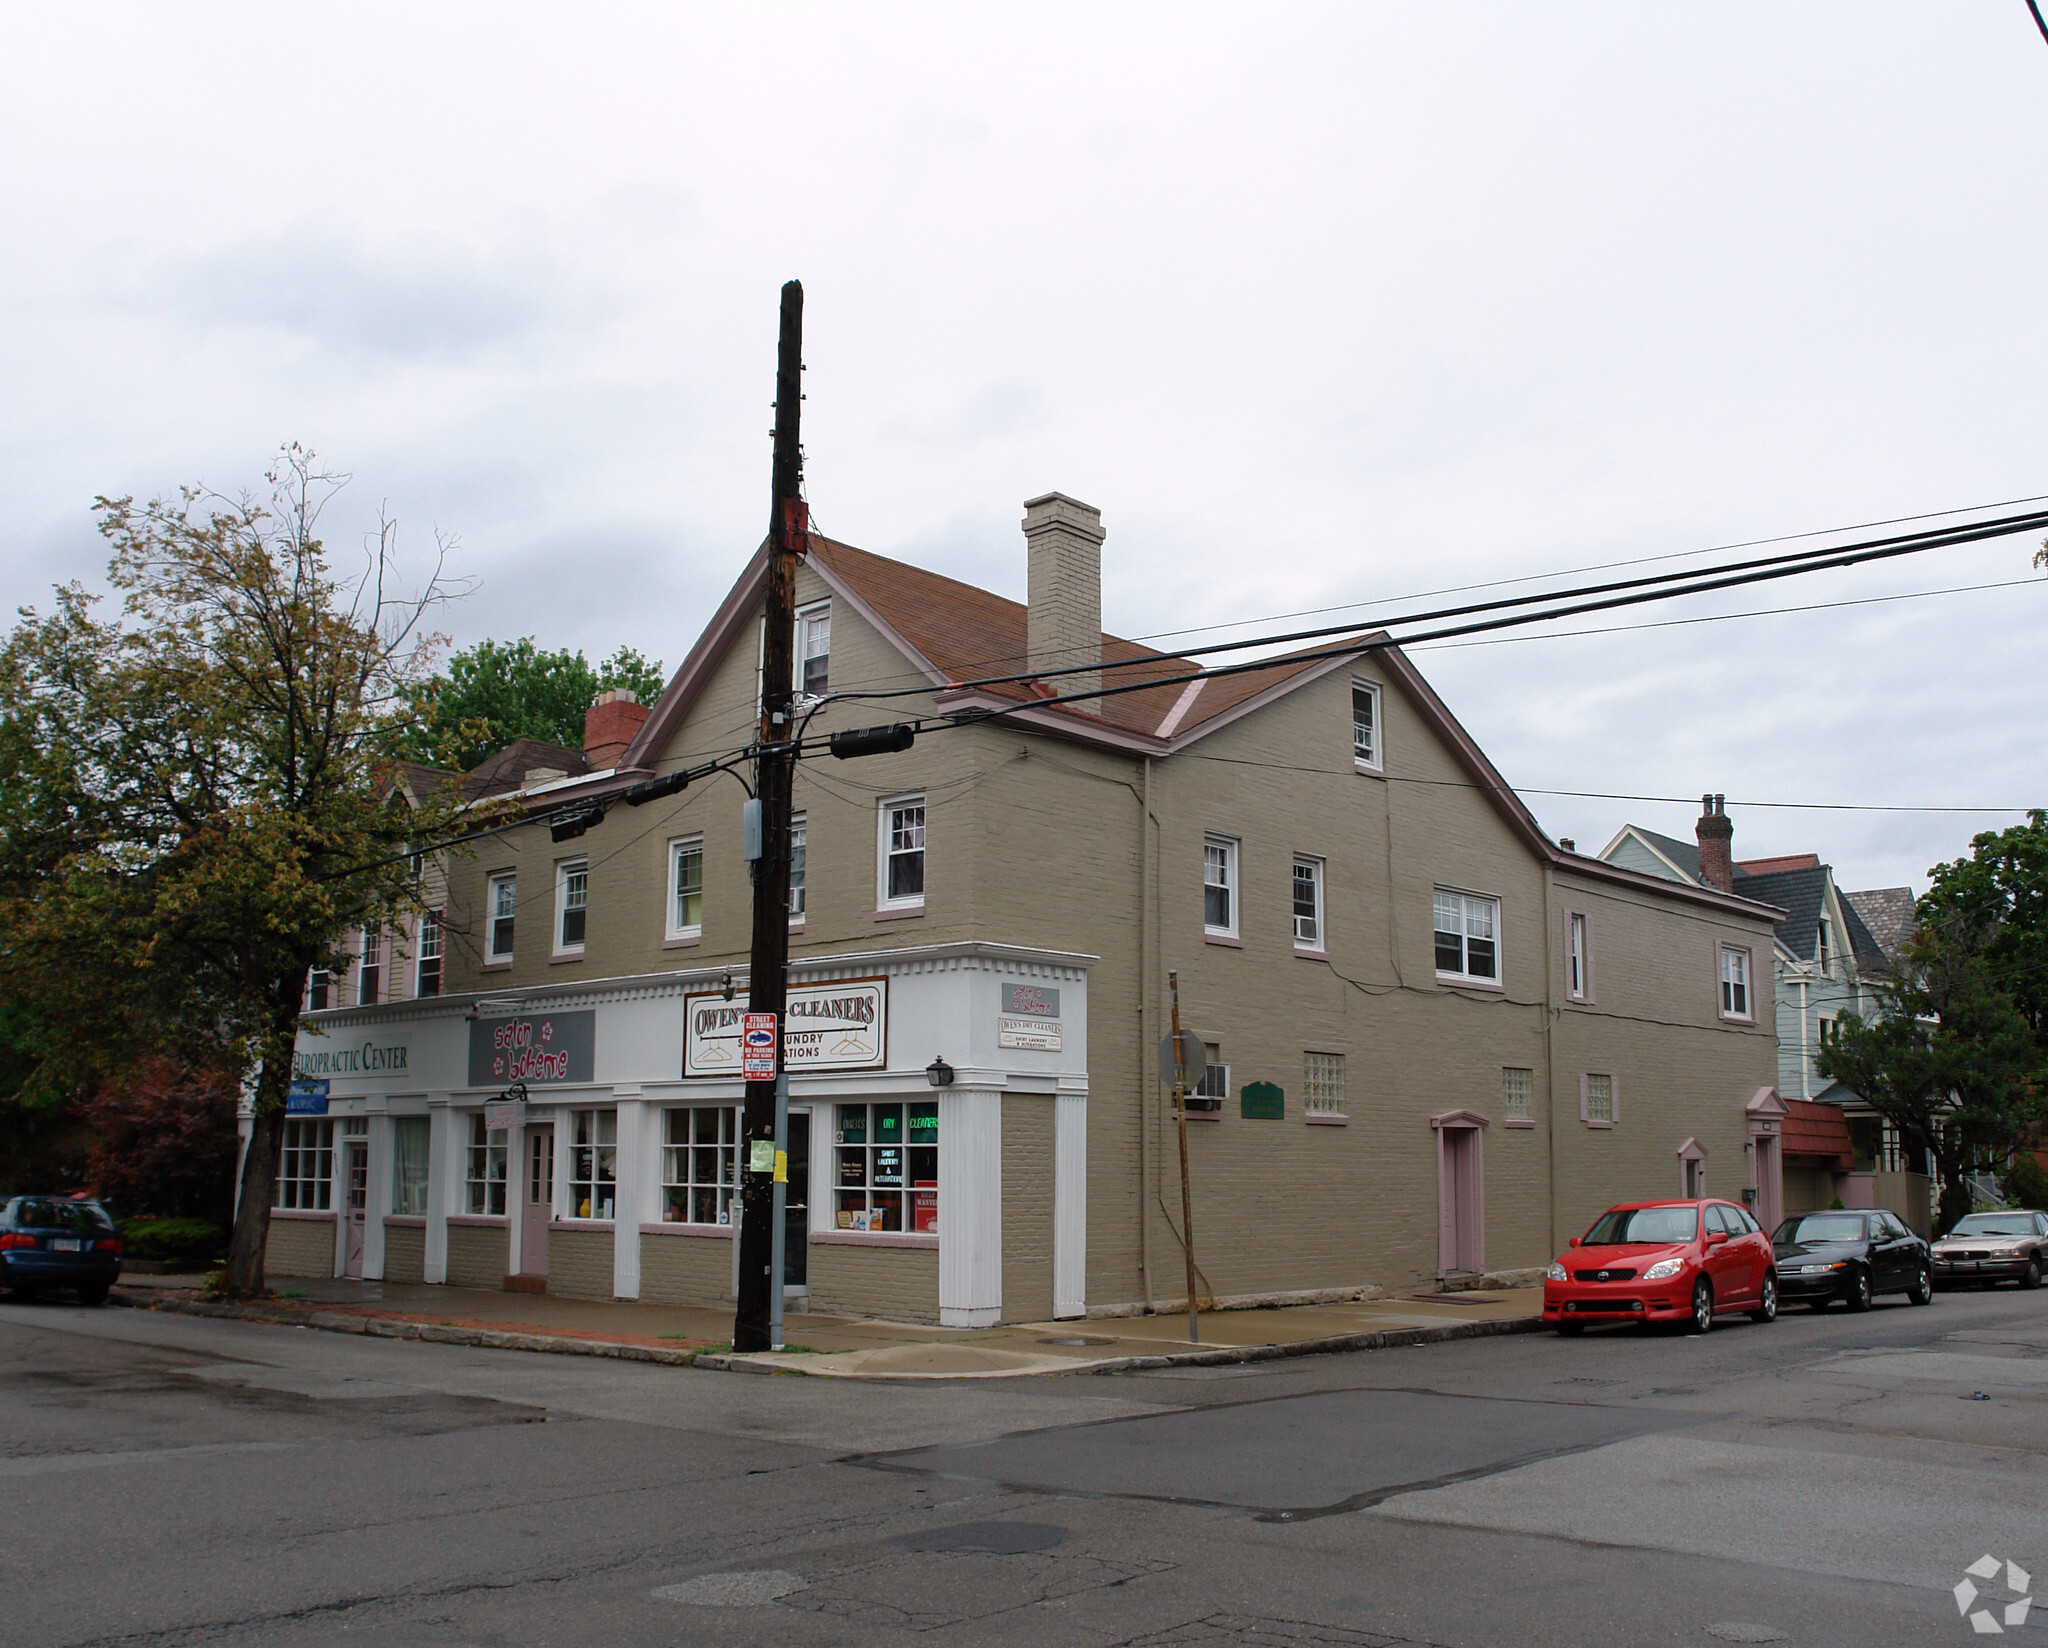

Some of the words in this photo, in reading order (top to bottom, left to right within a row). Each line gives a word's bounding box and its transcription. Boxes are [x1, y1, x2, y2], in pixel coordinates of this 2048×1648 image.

[789, 996, 875, 1024] CLEANERS
[495, 1018, 532, 1049] salon
[784, 1033, 824, 1046] UNDRY
[292, 1049, 360, 1074] HIROPRACTIC
[784, 1047, 821, 1059] ATIONS
[508, 1045, 568, 1081] bohème
[883, 1119, 895, 1129] DRY
[917, 1198, 937, 1206] WANTE
